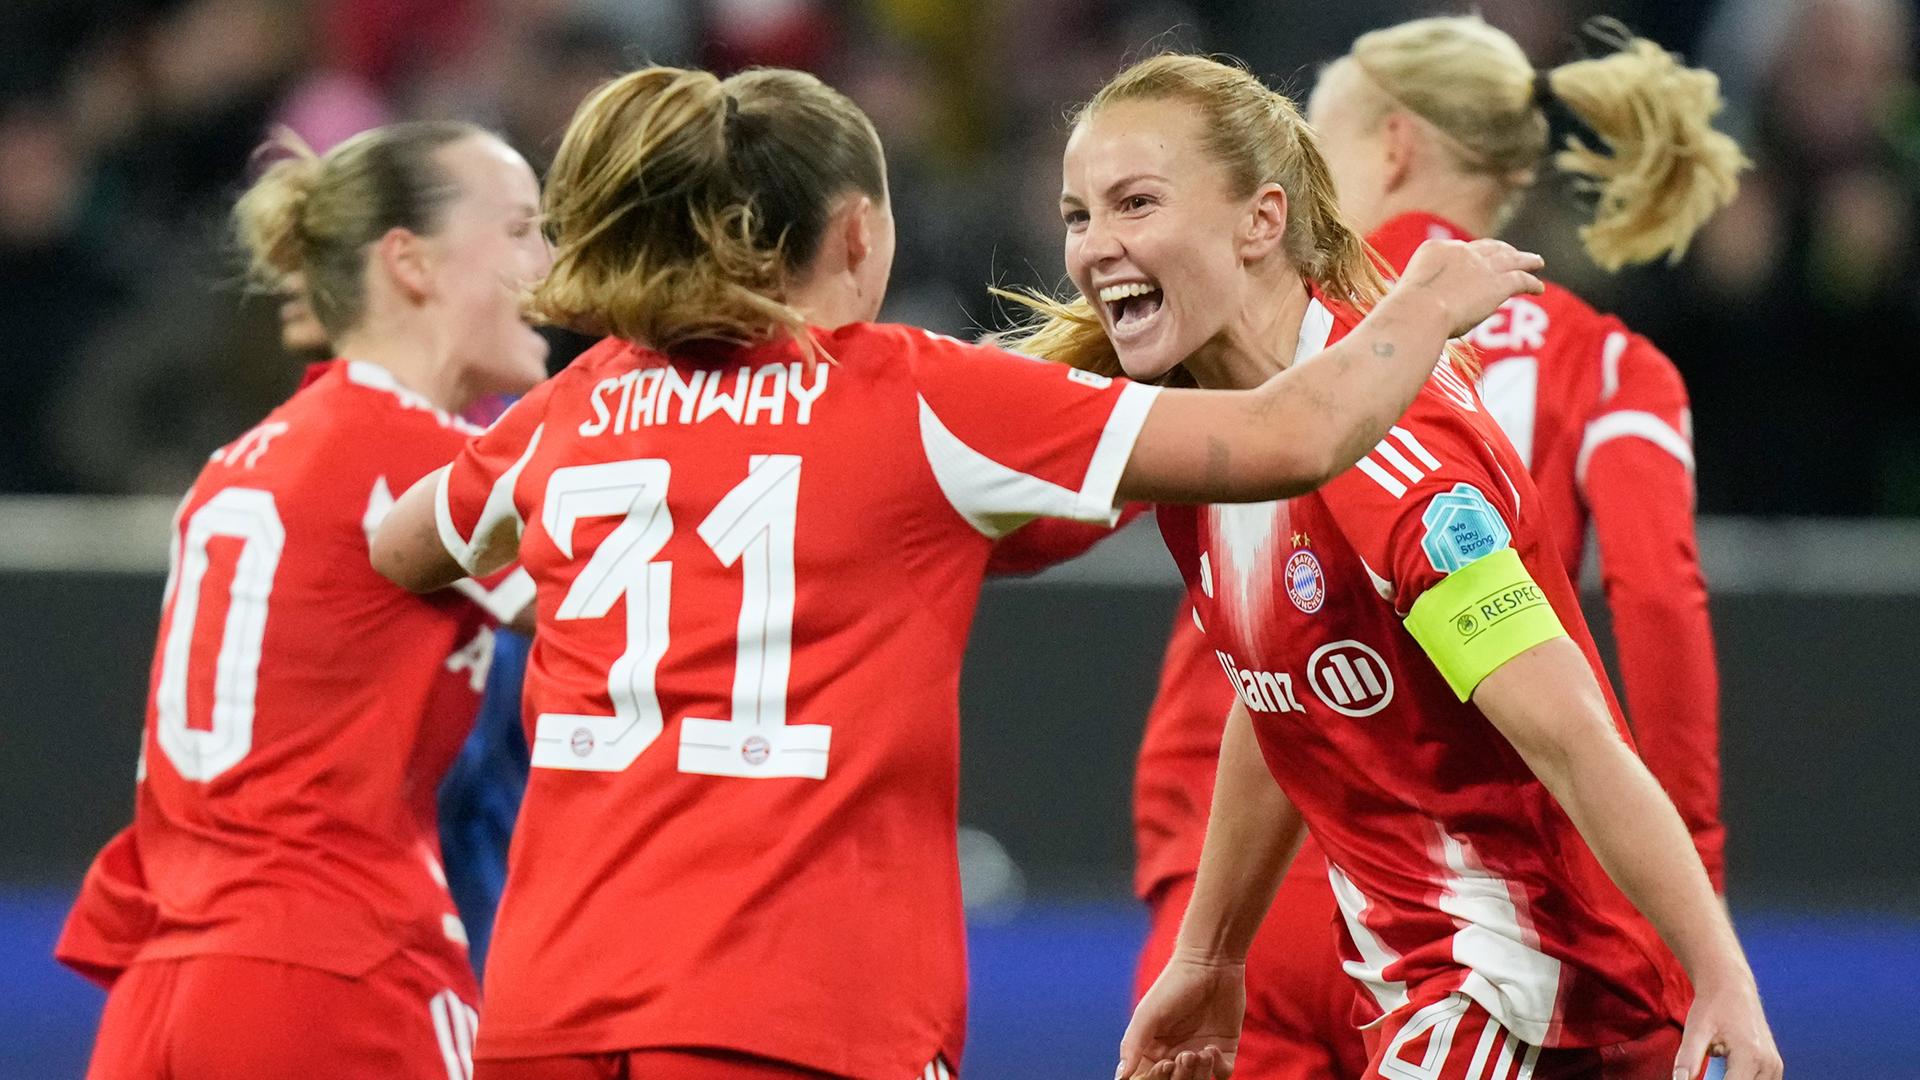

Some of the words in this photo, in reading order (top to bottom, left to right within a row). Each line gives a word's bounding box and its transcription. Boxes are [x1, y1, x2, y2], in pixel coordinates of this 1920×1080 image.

[578, 362, 830, 437] STANWAY
[1449, 522, 1467, 532] We
[1455, 530, 1479, 544] Play
[1460, 534, 1495, 556] Strong
[1294, 555, 1320, 578] BAYERN
[530, 454, 833, 779] 31
[1481, 585, 1543, 621] RESPEC
[1215, 649, 1307, 714] llianz
